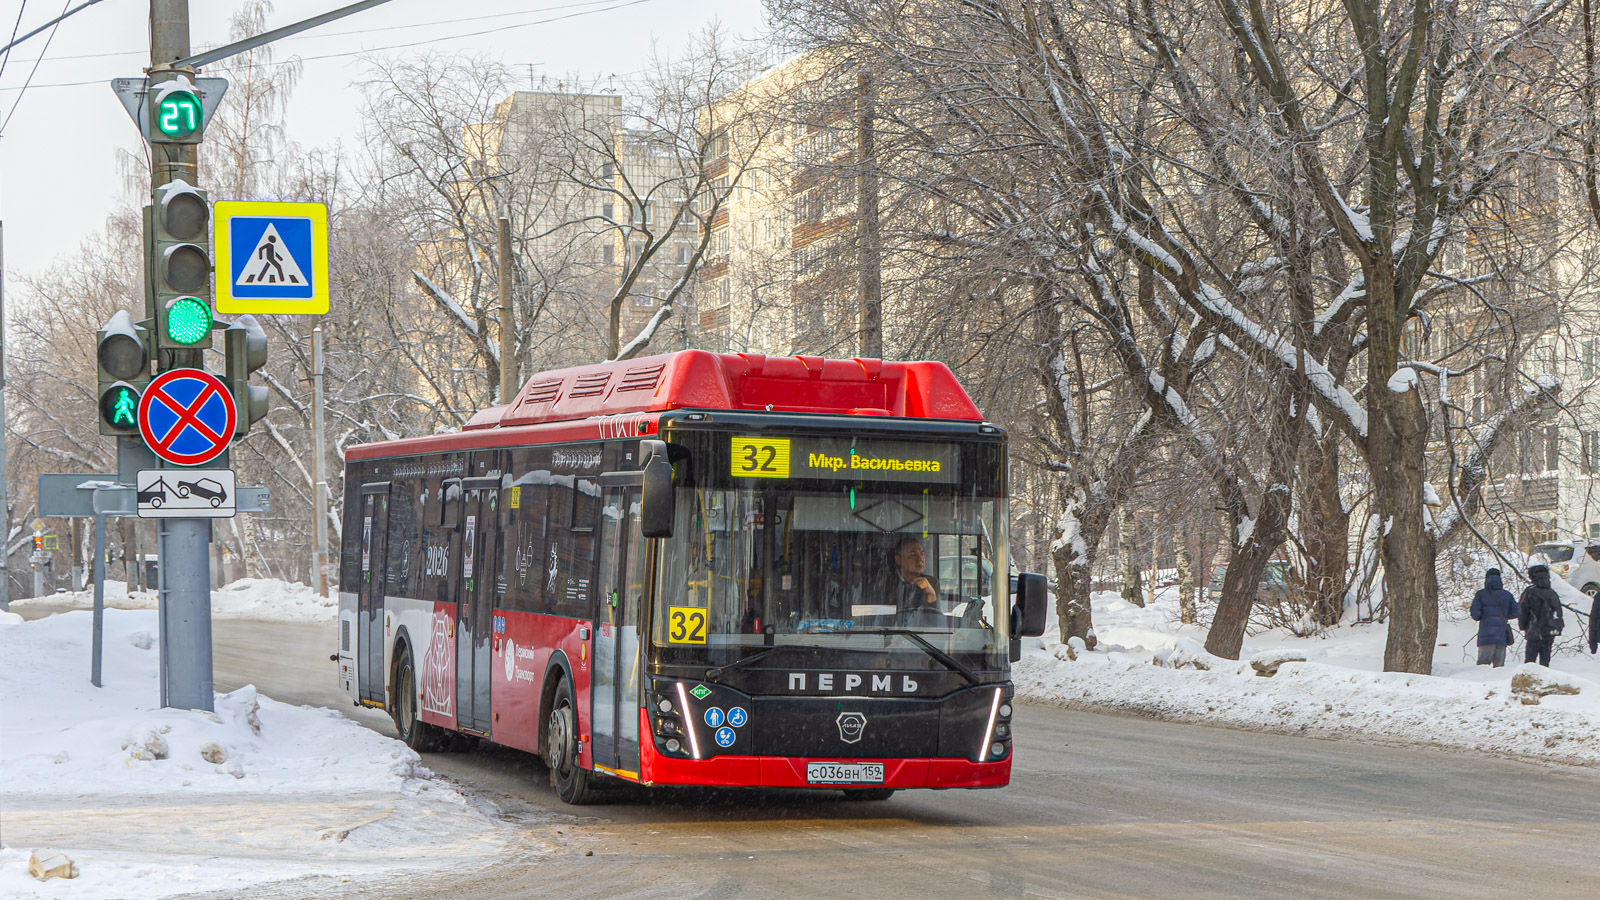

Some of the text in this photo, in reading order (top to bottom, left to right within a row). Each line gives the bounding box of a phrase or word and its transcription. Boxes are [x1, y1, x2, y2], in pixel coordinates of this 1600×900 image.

[162, 103, 195, 131] 27
[741, 444, 941, 473] 32 Мкр. Васильевка
[426, 545, 449, 577] 2026
[670, 611, 706, 642] 32
[788, 673, 919, 693] ПЕРМЬ
[862, 766, 881, 777] 159
